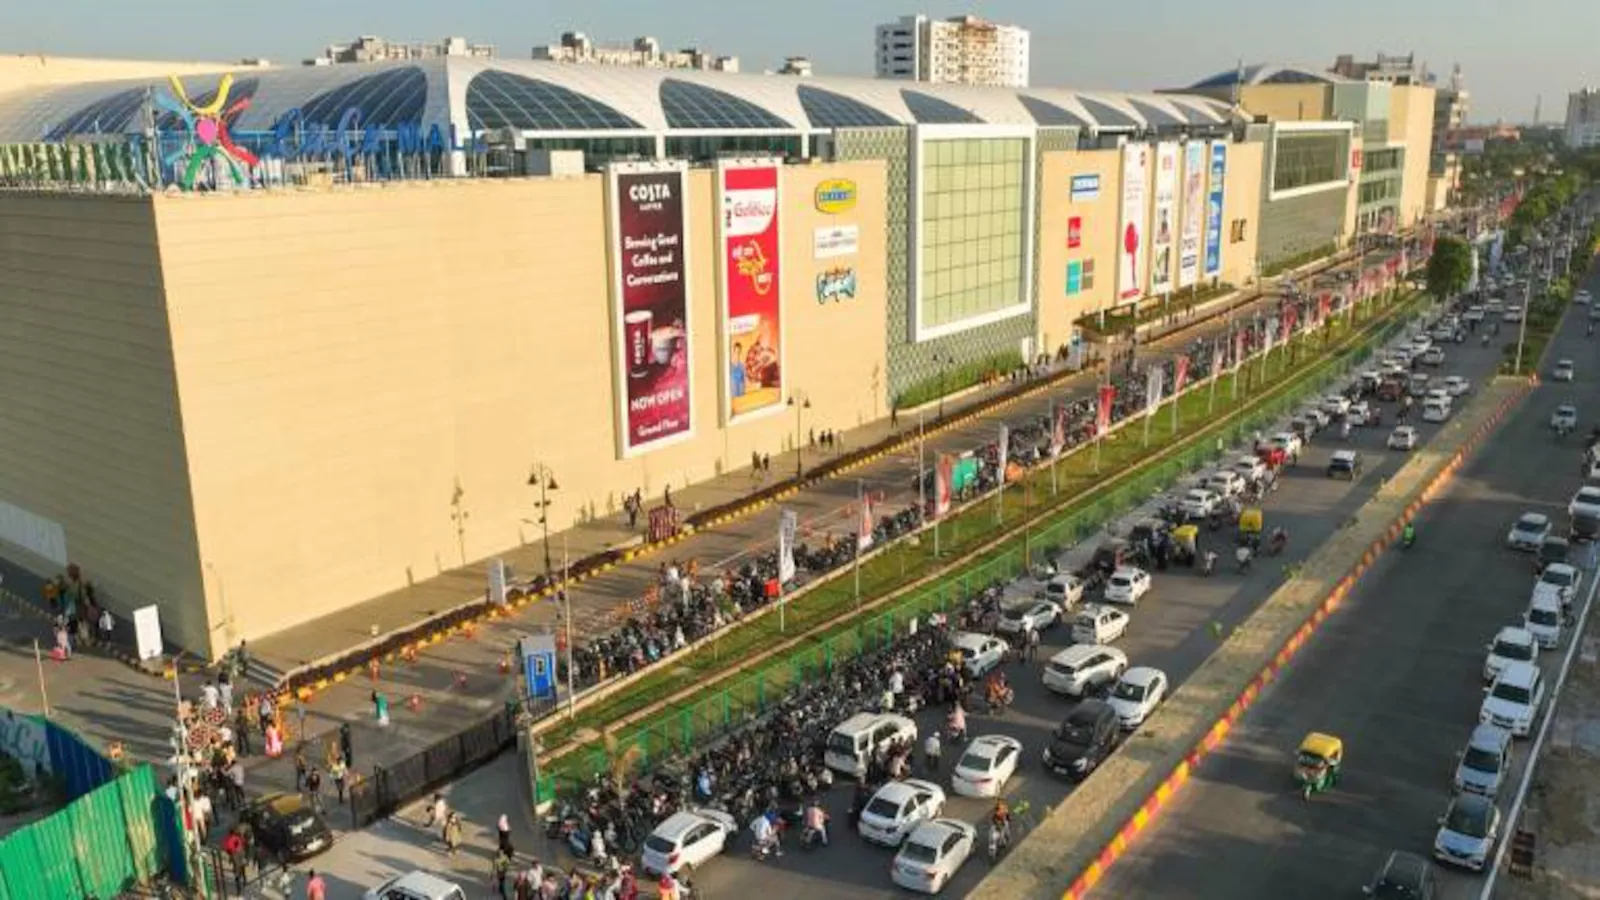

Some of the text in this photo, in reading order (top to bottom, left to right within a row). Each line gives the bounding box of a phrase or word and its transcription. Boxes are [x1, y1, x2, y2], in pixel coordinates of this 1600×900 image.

[628, 184, 671, 202] COSTA
[631, 250, 674, 267] Coffee and
[630, 387, 684, 412] NOW OPEN
[636, 420, 662, 437] Ground
